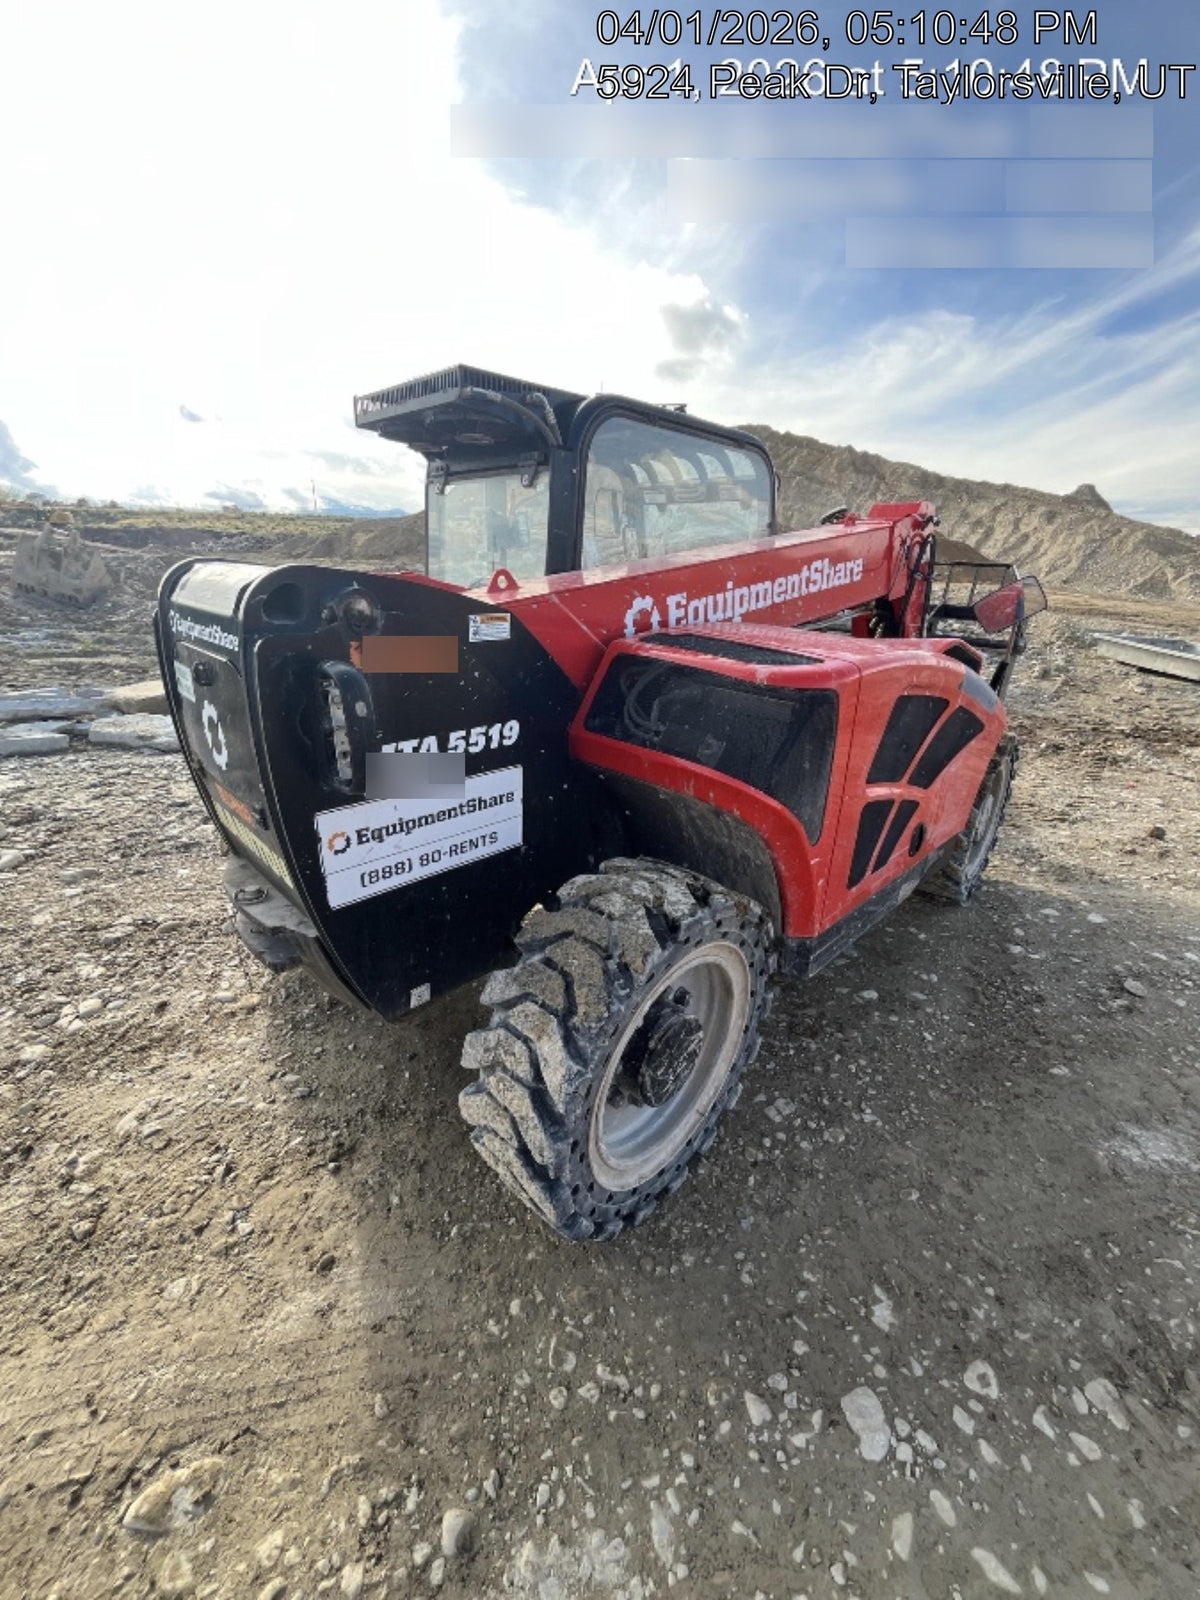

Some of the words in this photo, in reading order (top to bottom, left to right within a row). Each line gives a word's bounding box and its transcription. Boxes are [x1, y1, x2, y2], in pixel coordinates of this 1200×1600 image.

[447, 719, 521, 754] 5519
[355, 791, 515, 845] EquipmentShare
[360, 860, 414, 888] (888)
[418, 831, 499, 868] 80-RENTS
